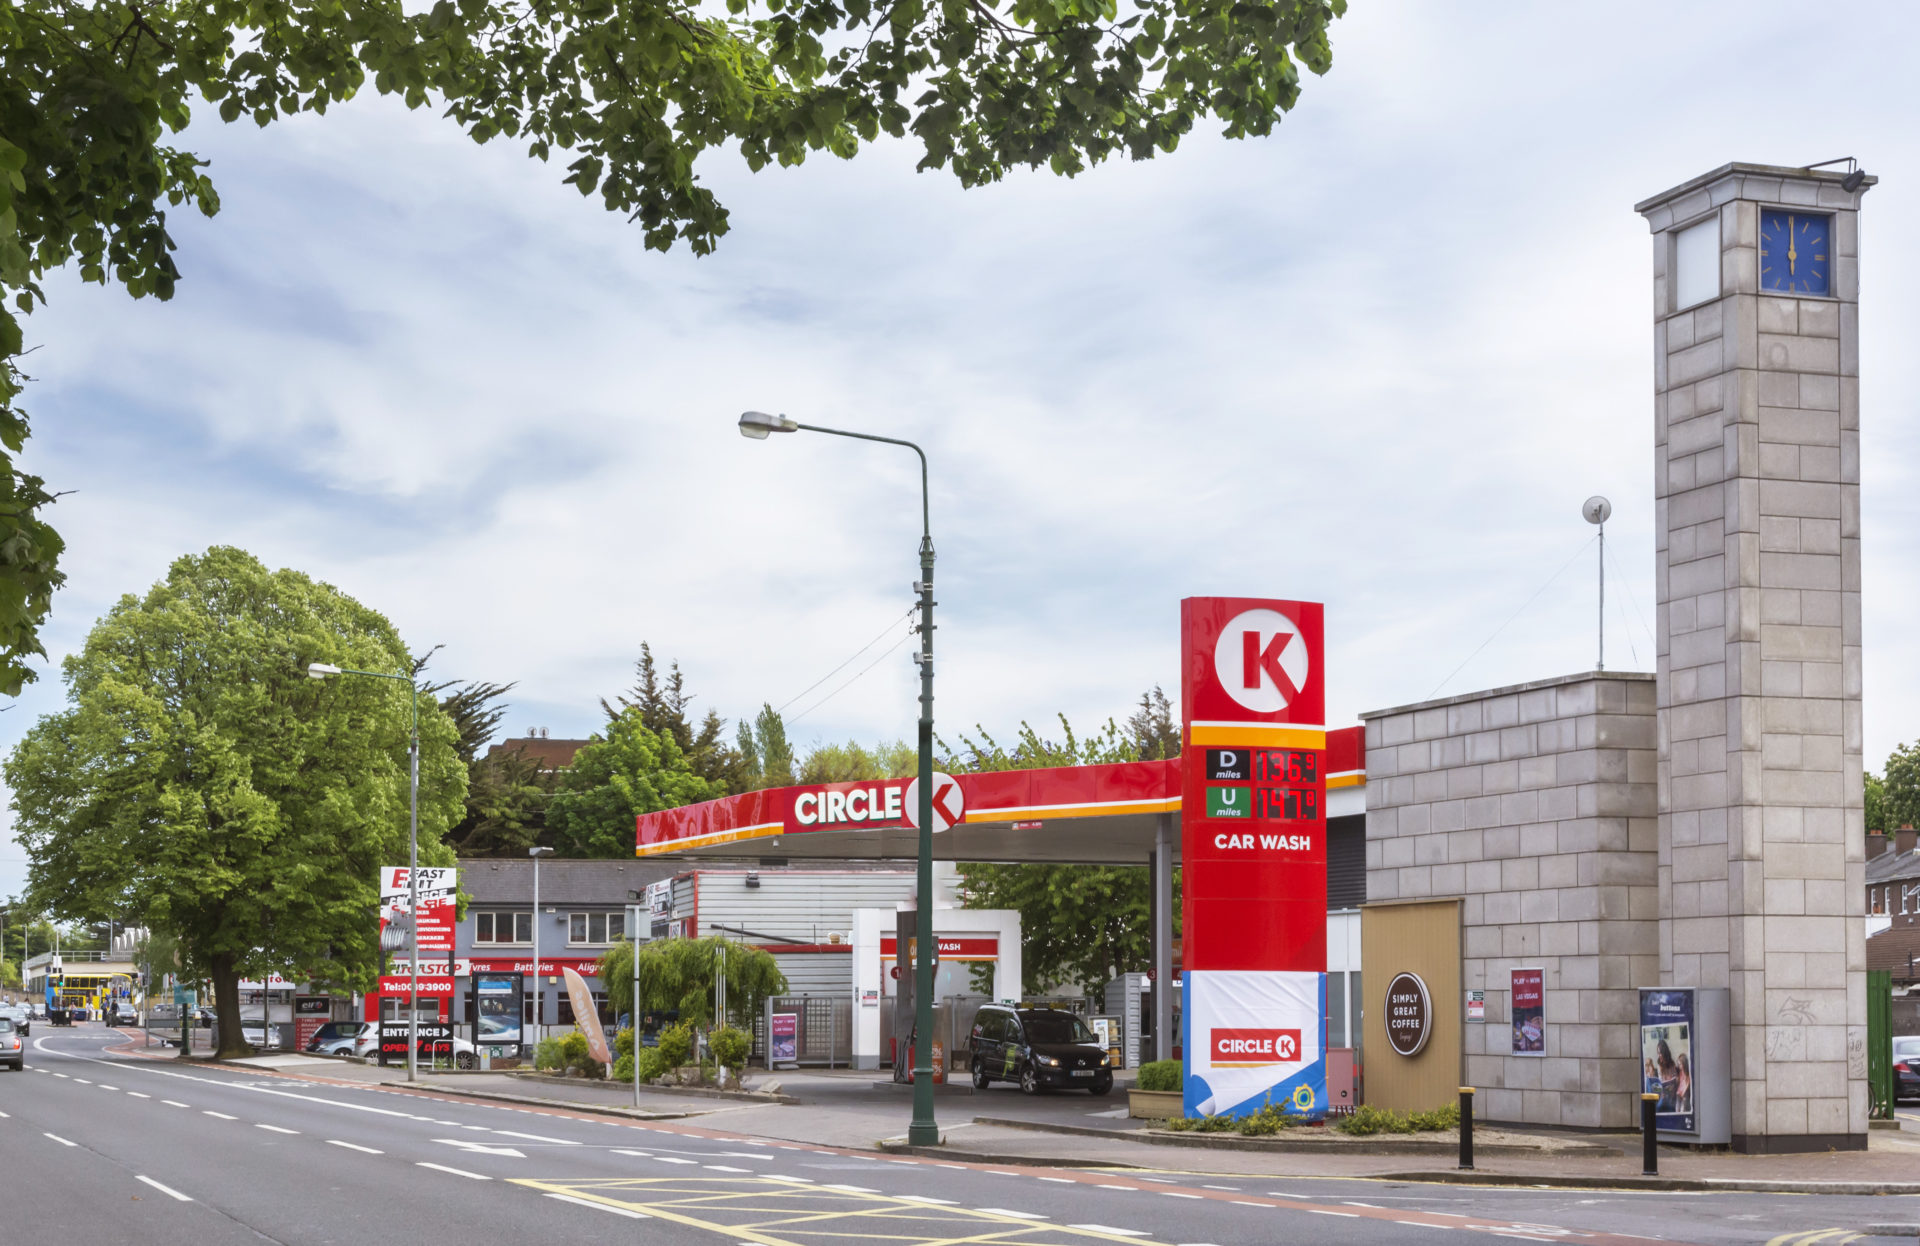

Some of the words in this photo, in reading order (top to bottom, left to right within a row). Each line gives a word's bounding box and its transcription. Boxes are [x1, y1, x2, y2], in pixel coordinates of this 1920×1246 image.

[1242, 630, 1302, 706] K
[1219, 750, 1237, 768] D
[1215, 770, 1241, 779] miles
[1221, 788, 1236, 805] U
[795, 786, 901, 825] CIRCLE
[1216, 808, 1241, 816] miles
[1214, 834, 1255, 850] CAR
[1259, 834, 1311, 851] WASH
[514, 962, 554, 972] Battries
[1392, 994, 1418, 1004] SIMPLY
[1393, 1006, 1418, 1016] GREAT
[1391, 1019, 1420, 1029] COFFEE
[382, 1028, 440, 1037] ENTRNCE
[423, 1043, 450, 1052] DAYS
[1218, 1039, 1273, 1054] CIRCLE
